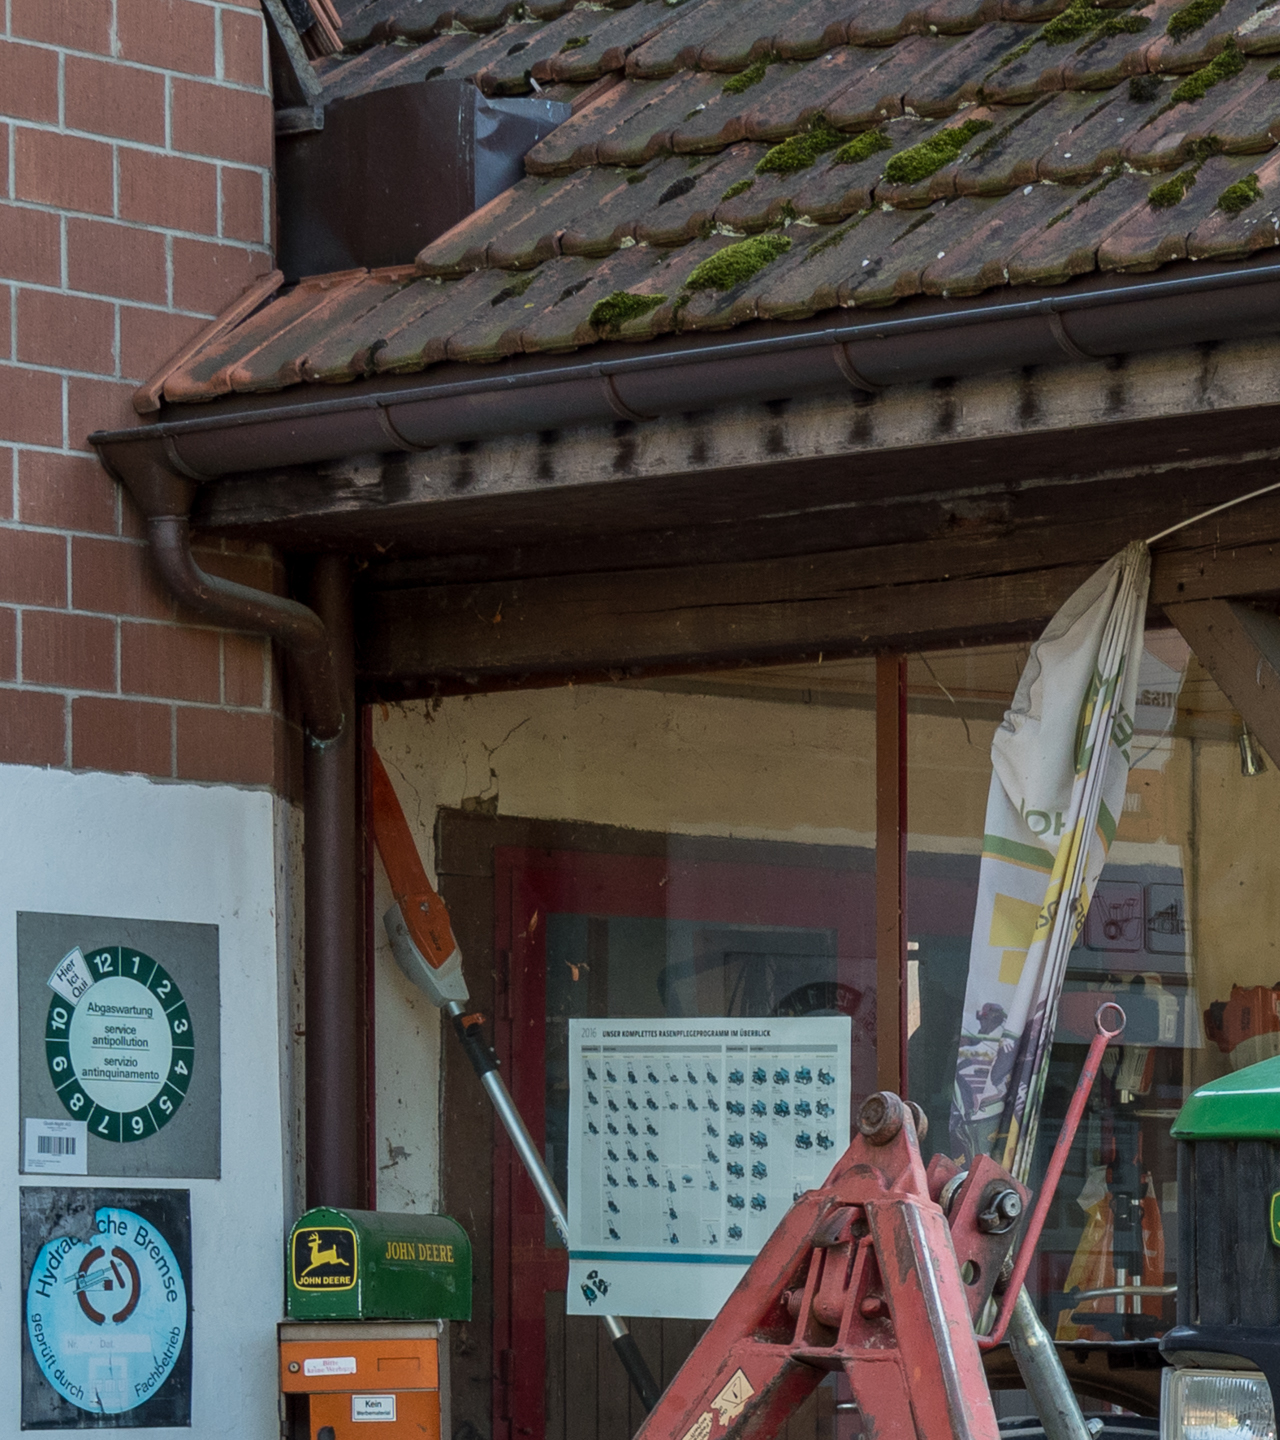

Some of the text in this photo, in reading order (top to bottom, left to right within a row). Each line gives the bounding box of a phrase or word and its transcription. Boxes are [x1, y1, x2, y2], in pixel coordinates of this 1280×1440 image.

[56, 958, 77, 982] Hier
[94, 953, 113, 973] 12
[132, 956, 140, 974] 1
[67, 970, 80, 988] Ici
[72, 978, 89, 999] Qui
[157, 979, 172, 998] 2
[51, 1007, 68, 1030] 10
[87, 1002, 153, 1018] Abgaswartung
[104, 1023, 136, 1035] service
[173, 1019, 188, 1034] 3
[581, 1027, 771, 1038] 2016 UNSER KOMPLETTES RASENPFLEGEPROGRAMM IM ÜBERBLICK
[92, 1035, 149, 1049] antipollution
[52, 1056, 68, 1072] 9
[103, 1056, 138, 1067] servizio
[173, 1060, 188, 1076] 4
[81, 1067, 160, 1080] antinquinamento
[69, 1093, 85, 1111] 8
[159, 1096, 174, 1115] 5
[98, 1115, 110, 1134] 7
[131, 1116, 144, 1135] 6
[386, 1241, 455, 1263] JOHN DEERE
[134, 1226, 178, 1304] Bremse
[298, 1276, 351, 1285] JOHN DEERE
[31, 1313, 181, 1400] geprüft durch Fachbetrieb
[365, 1399, 382, 1408] Kein
